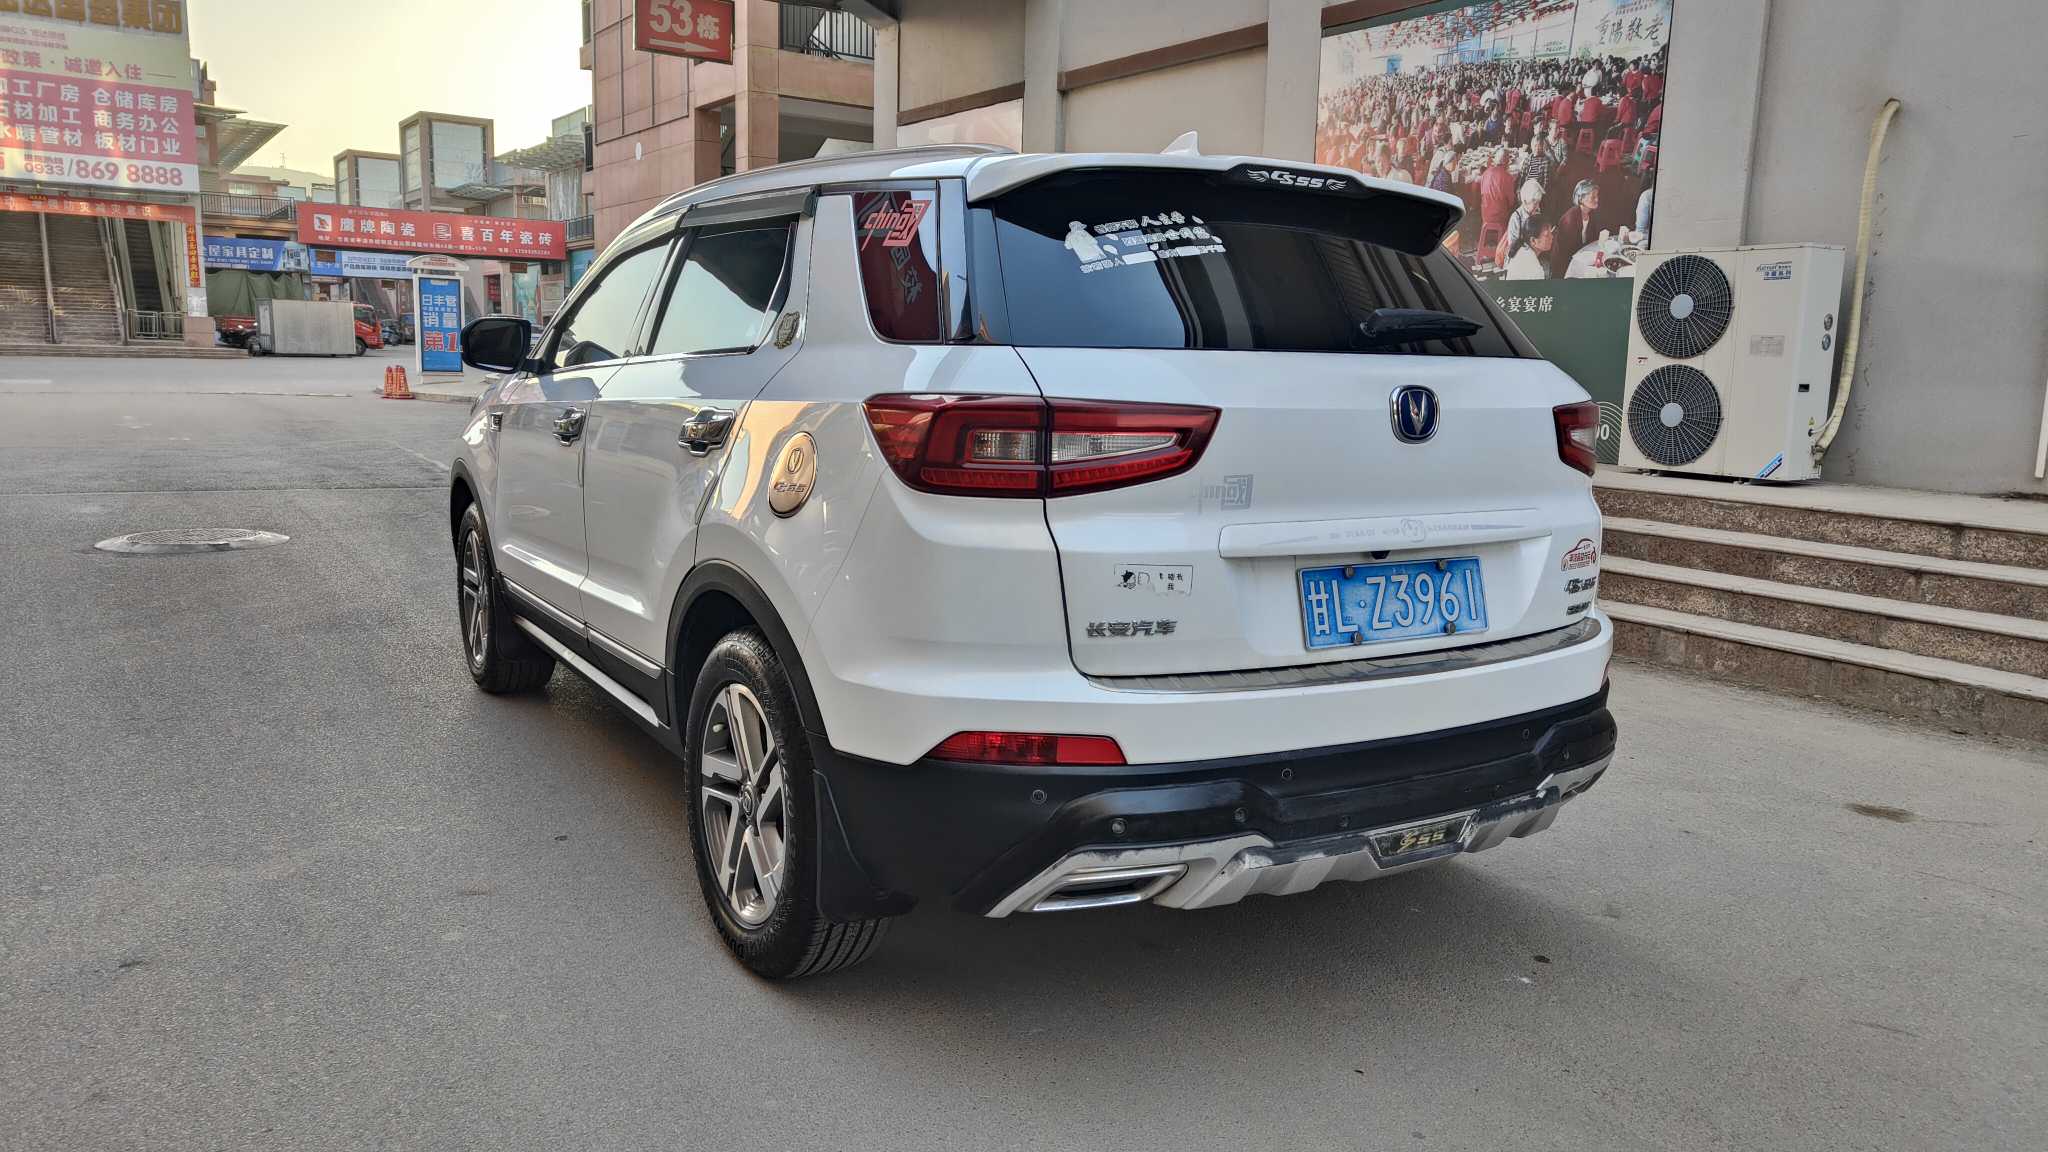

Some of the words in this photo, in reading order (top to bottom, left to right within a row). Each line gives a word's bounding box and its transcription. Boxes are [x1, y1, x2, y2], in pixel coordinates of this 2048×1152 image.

[92, 87, 179, 113] 仓储库房
[94, 109, 179, 134] 商务办公
[95, 131, 181, 156] 板材门业
[1086, 620, 1179, 637] 长安汽车
